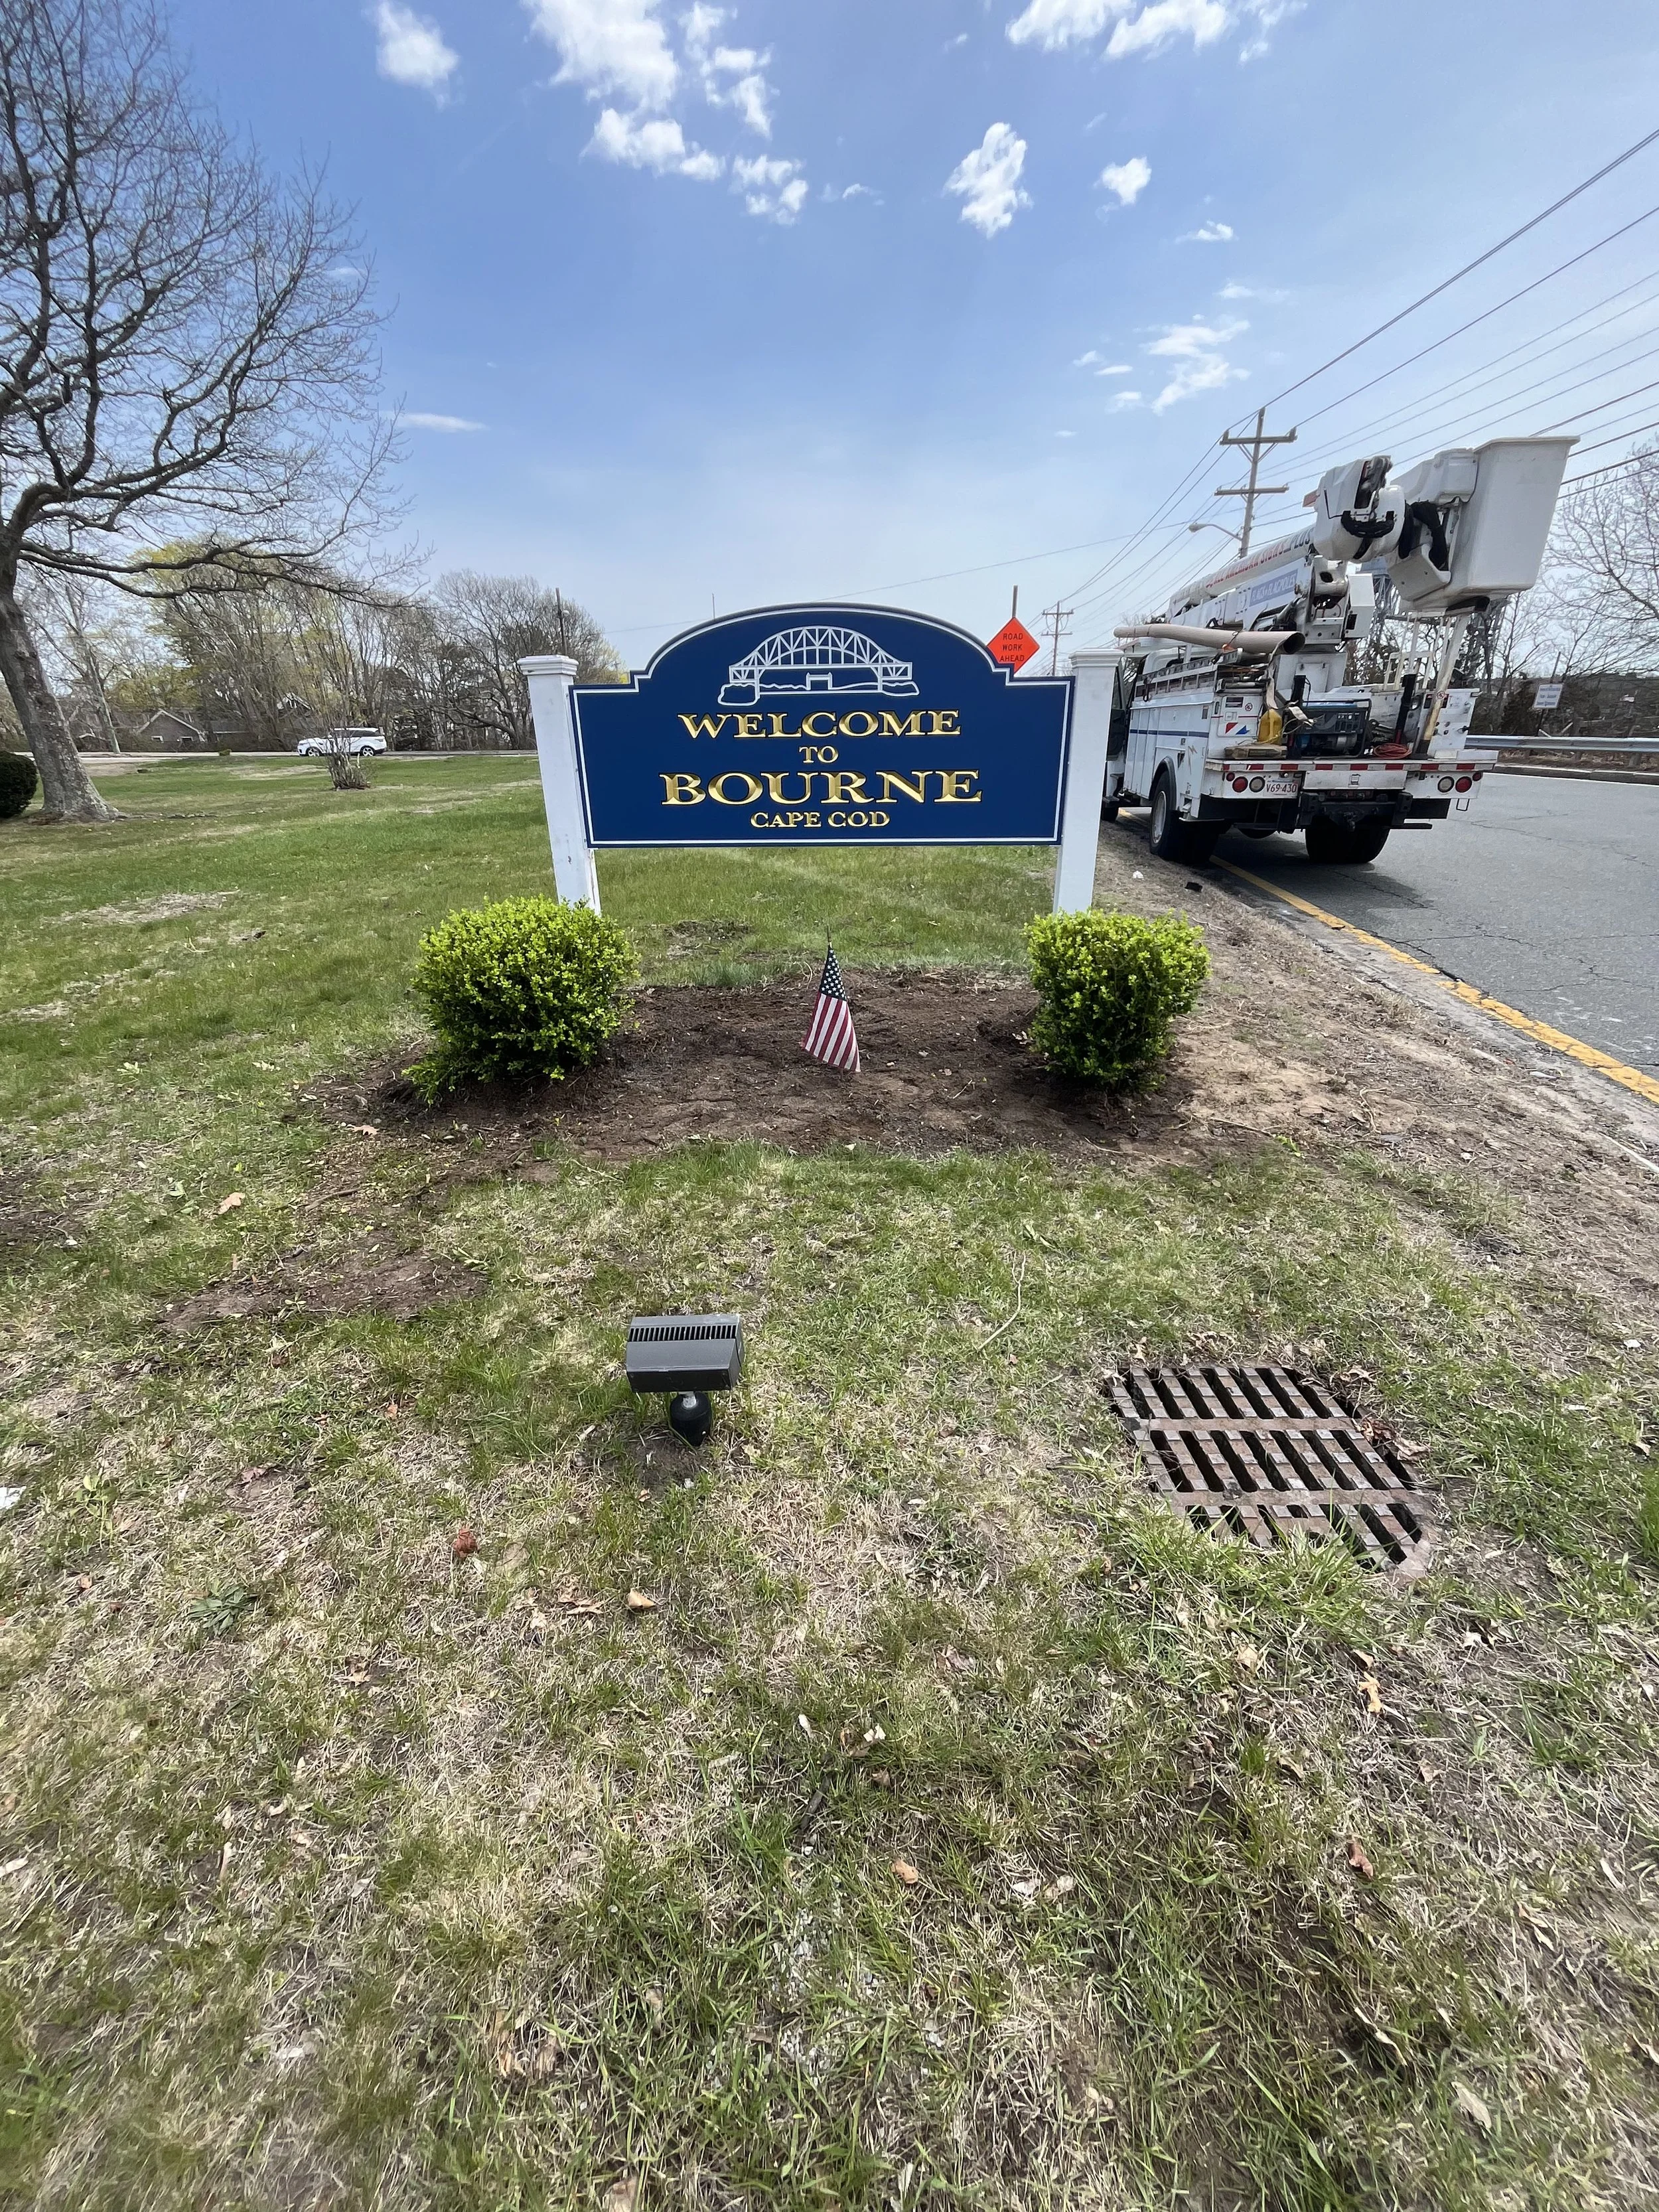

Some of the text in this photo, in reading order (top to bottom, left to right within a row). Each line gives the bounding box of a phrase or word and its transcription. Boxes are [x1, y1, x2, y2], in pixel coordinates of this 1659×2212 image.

[678, 710, 962, 739] WELCOME
[799, 745, 839, 764] TO
[660, 769, 982, 805] BOURNE
[750, 811, 891, 828] CAPE COD
